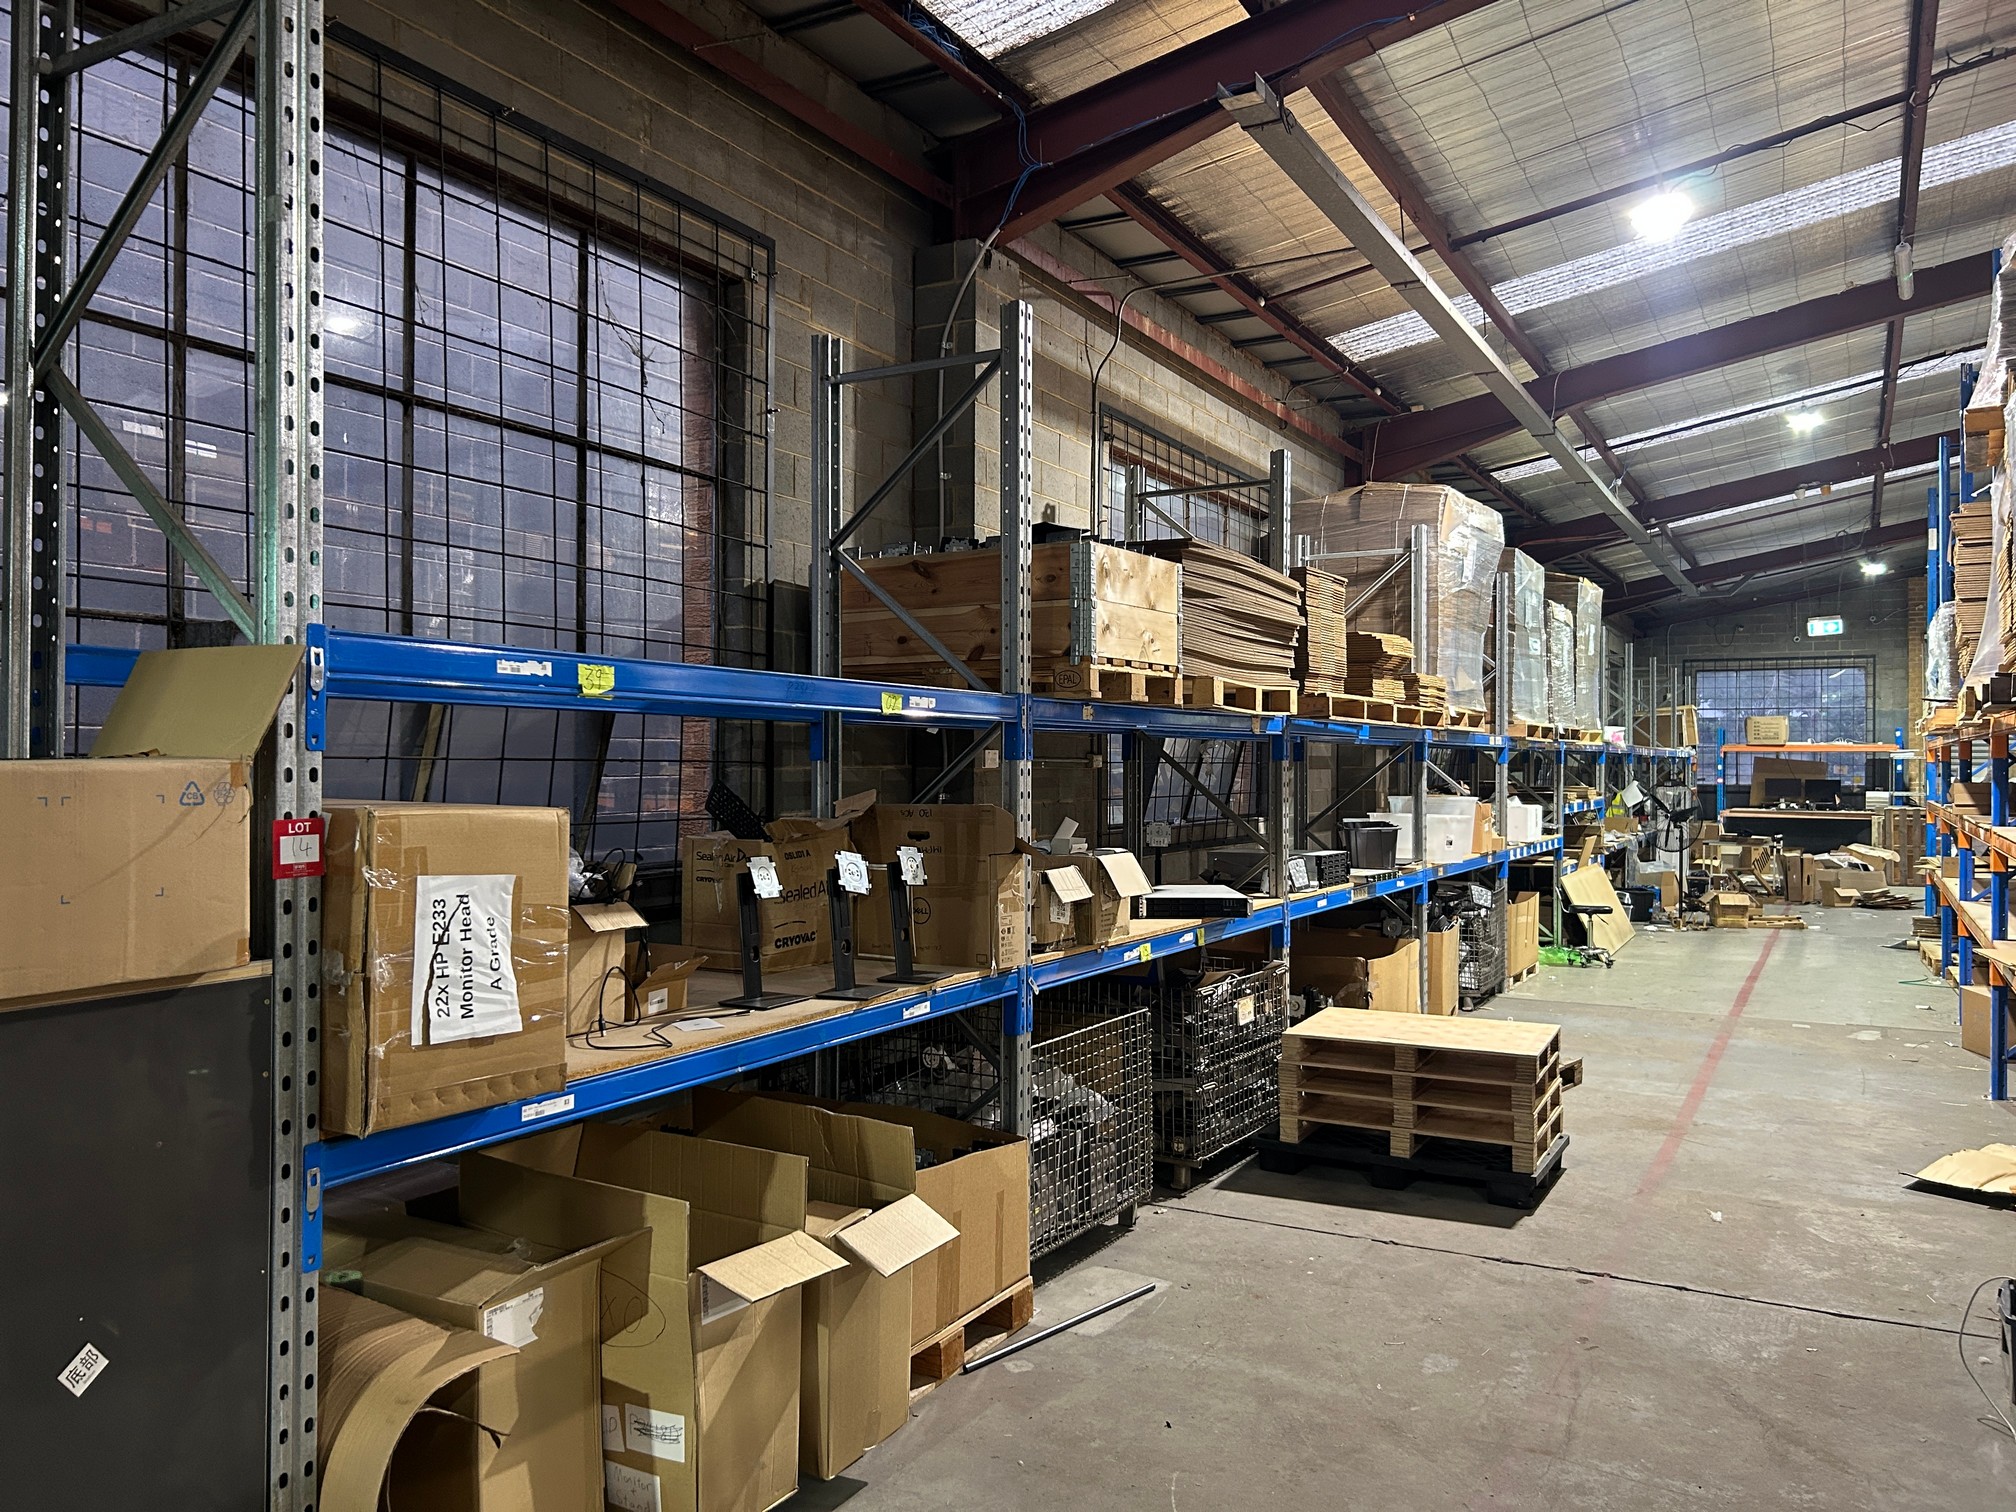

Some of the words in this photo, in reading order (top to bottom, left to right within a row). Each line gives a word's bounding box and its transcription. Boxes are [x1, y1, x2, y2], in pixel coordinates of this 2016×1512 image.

[1059, 674, 1077, 685] EPAL
[288, 821, 312, 834] LOT
[292, 836, 312, 857] 14
[432, 898, 450, 946] E233
[456, 894, 472, 942] Head
[486, 916, 501, 972] Grade
[774, 930, 816, 949] CRYOVAC
[435, 952, 450, 979] HP
[459, 947, 474, 1019] Monitor
[490, 977, 502, 990] A
[436, 984, 450, 1018] 22x
[65, 1348, 99, 1389] 底部
